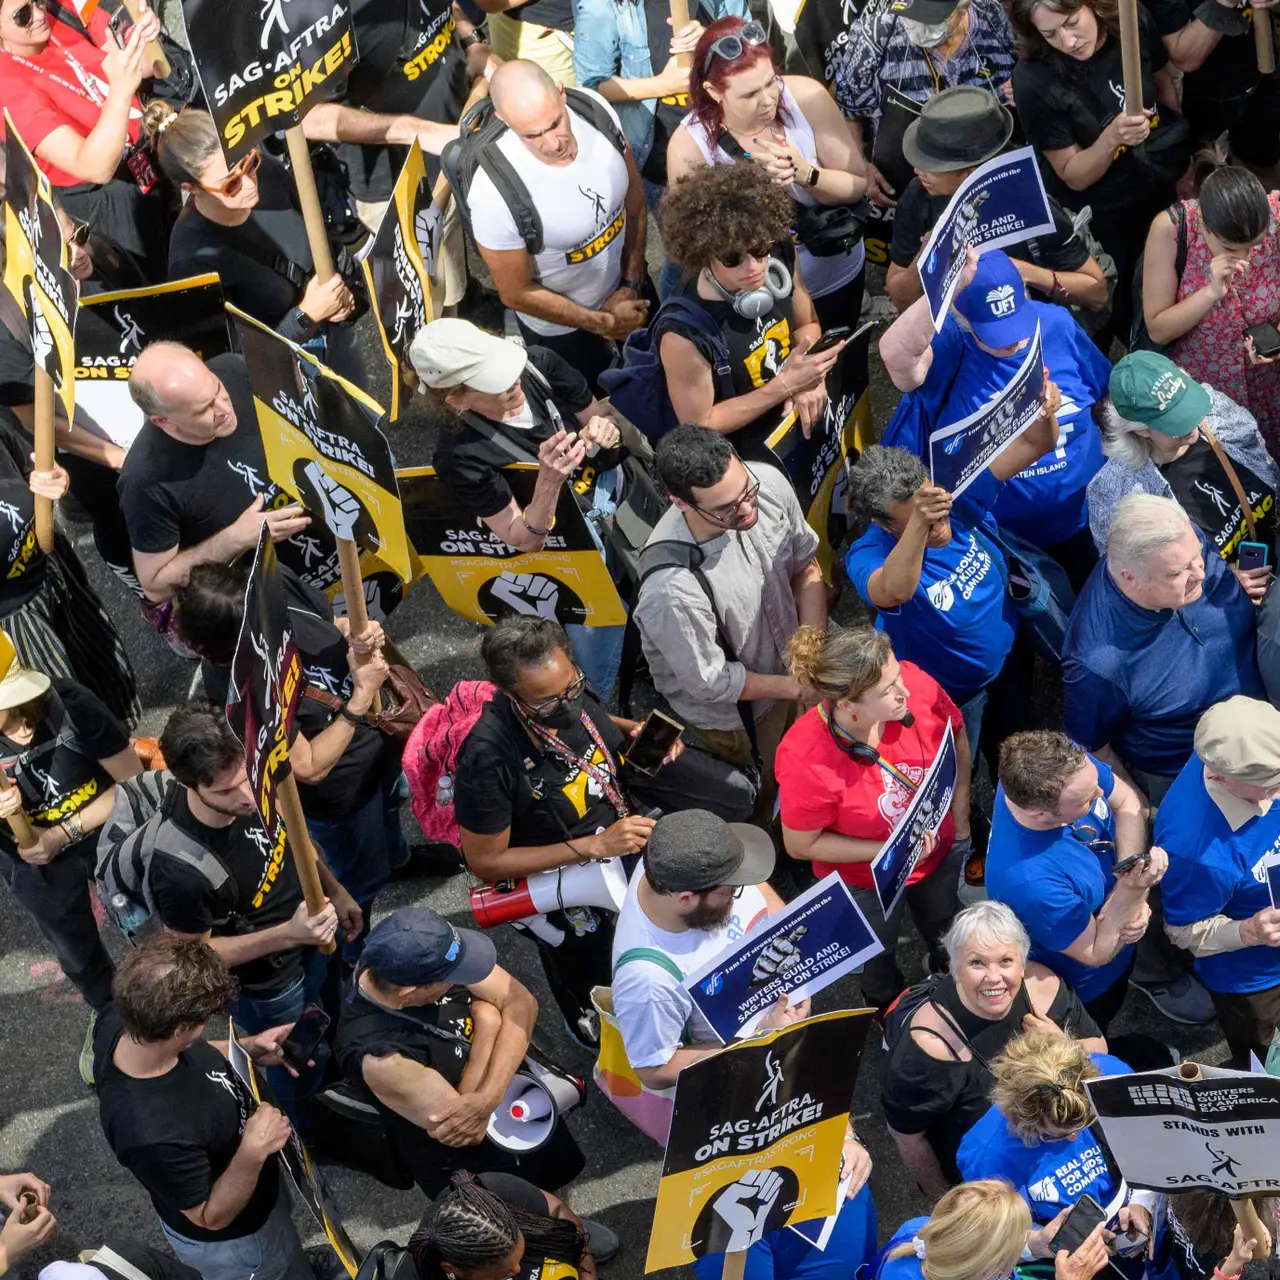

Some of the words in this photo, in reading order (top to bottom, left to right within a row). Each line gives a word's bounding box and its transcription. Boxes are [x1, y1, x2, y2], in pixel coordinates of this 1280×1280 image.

[273, 64, 301, 88] ON
[222, 30, 353, 150] STRIKE!
[983, 220, 1025, 239] STRIKE!
[991, 213, 1017, 227] AND
[990, 297, 1016, 317] UFT
[1149, 370, 1174, 396] FEELING
[1034, 461, 1067, 476] ISLAND
[440, 540, 475, 554] ON
[737, 985, 793, 1024] SAG-AFTRA
[793, 971, 811, 989] ON
[810, 946, 852, 977] STRIKE!
[738, 975, 782, 1011] WRITERS
[782, 959, 817, 982] GUILD
[815, 941, 841, 962] AND
[1196, 1086, 1256, 1098] WRITERS
[1197, 1094, 1238, 1103] GUILD
[1212, 1095, 1279, 1107] AMERICA
[1199, 1104, 1234, 1113] EAST
[694, 1138, 730, 1161] ON
[736, 1102, 825, 1149] STRIKE!
[1162, 1119, 1222, 1139] STANDS
[1225, 1124, 1266, 1136] WITH
[1054, 1160, 1079, 1179] REAL
[1061, 1171, 1084, 1188] FOR
[1083, 1155, 1104, 1175] KIDS
